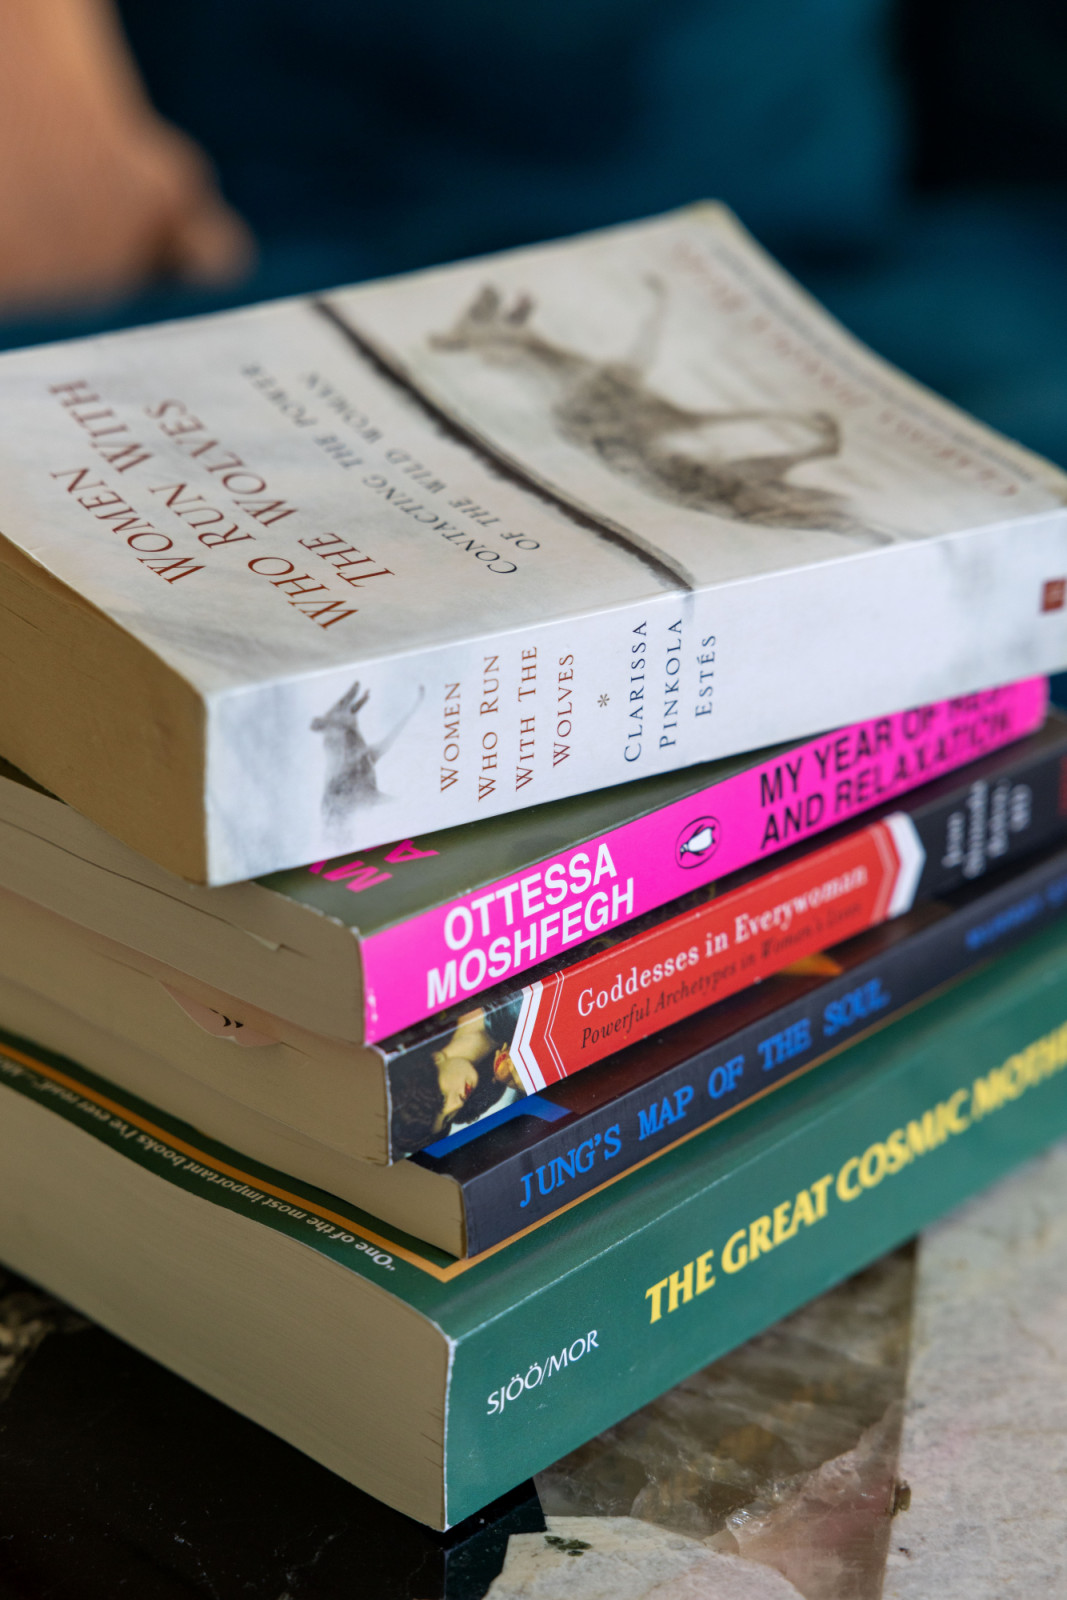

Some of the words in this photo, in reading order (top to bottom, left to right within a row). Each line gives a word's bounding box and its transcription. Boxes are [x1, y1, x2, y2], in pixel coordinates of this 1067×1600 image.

[46, 379, 155, 473] WITH
[144, 397, 300, 528] WOLVES
[312, 432, 364, 470] THE
[384, 448, 448, 494] WILD
[50, 467, 206, 585] WOMEN
[148, 481, 257, 549] RUN
[362, 474, 518, 574] CONTACTING
[447, 496, 501, 527] THE
[500, 531, 541, 551] OF
[248, 555, 359, 631] WHO
[297, 532, 396, 588] THE
[480, 655, 500, 716] RUN
[518, 646, 537, 702] THE
[552, 653, 574, 768] WOLVES
[624, 621, 647, 762] CLARISSA
[659, 619, 682, 749] PINKOLA
[695, 635, 716, 718] ESTÉS
[440, 682, 461, 792] WOMEN
[478, 731, 499, 801] WHO
[516, 715, 536, 791] WITH
[760, 755, 803, 808] MY
[814, 718, 893, 780] YEAR
[761, 793, 824, 850] AND
[444, 842, 618, 952] OTTESSA
[427, 876, 635, 1010] MOSHFEGH
[577, 945, 700, 1017] Goddesses
[705, 931, 729, 958] in
[734, 865, 869, 945] Everywoman
[581, 997, 651, 1049] Powerful
[654, 961, 737, 1014] Archetypes
[519, 1124, 622, 1208] JUNG'S
[637, 1084, 695, 1142] MAP
[707, 1055, 746, 1100] OF
[757, 1018, 812, 1071] THE
[823, 977, 892, 1036] SOUL
[137, 1134, 187, 1167] books
[182, 1160, 265, 1203] important
[262, 1197, 308, 1220] most
[306, 1217, 336, 1233] the
[328, 1231, 355, 1243] of
[644, 1248, 716, 1326] THE
[720, 1174, 835, 1275] GREAT
[835, 1088, 971, 1203] COSMIC
[486, 1329, 600, 1416] SJÖÖ/MOR
